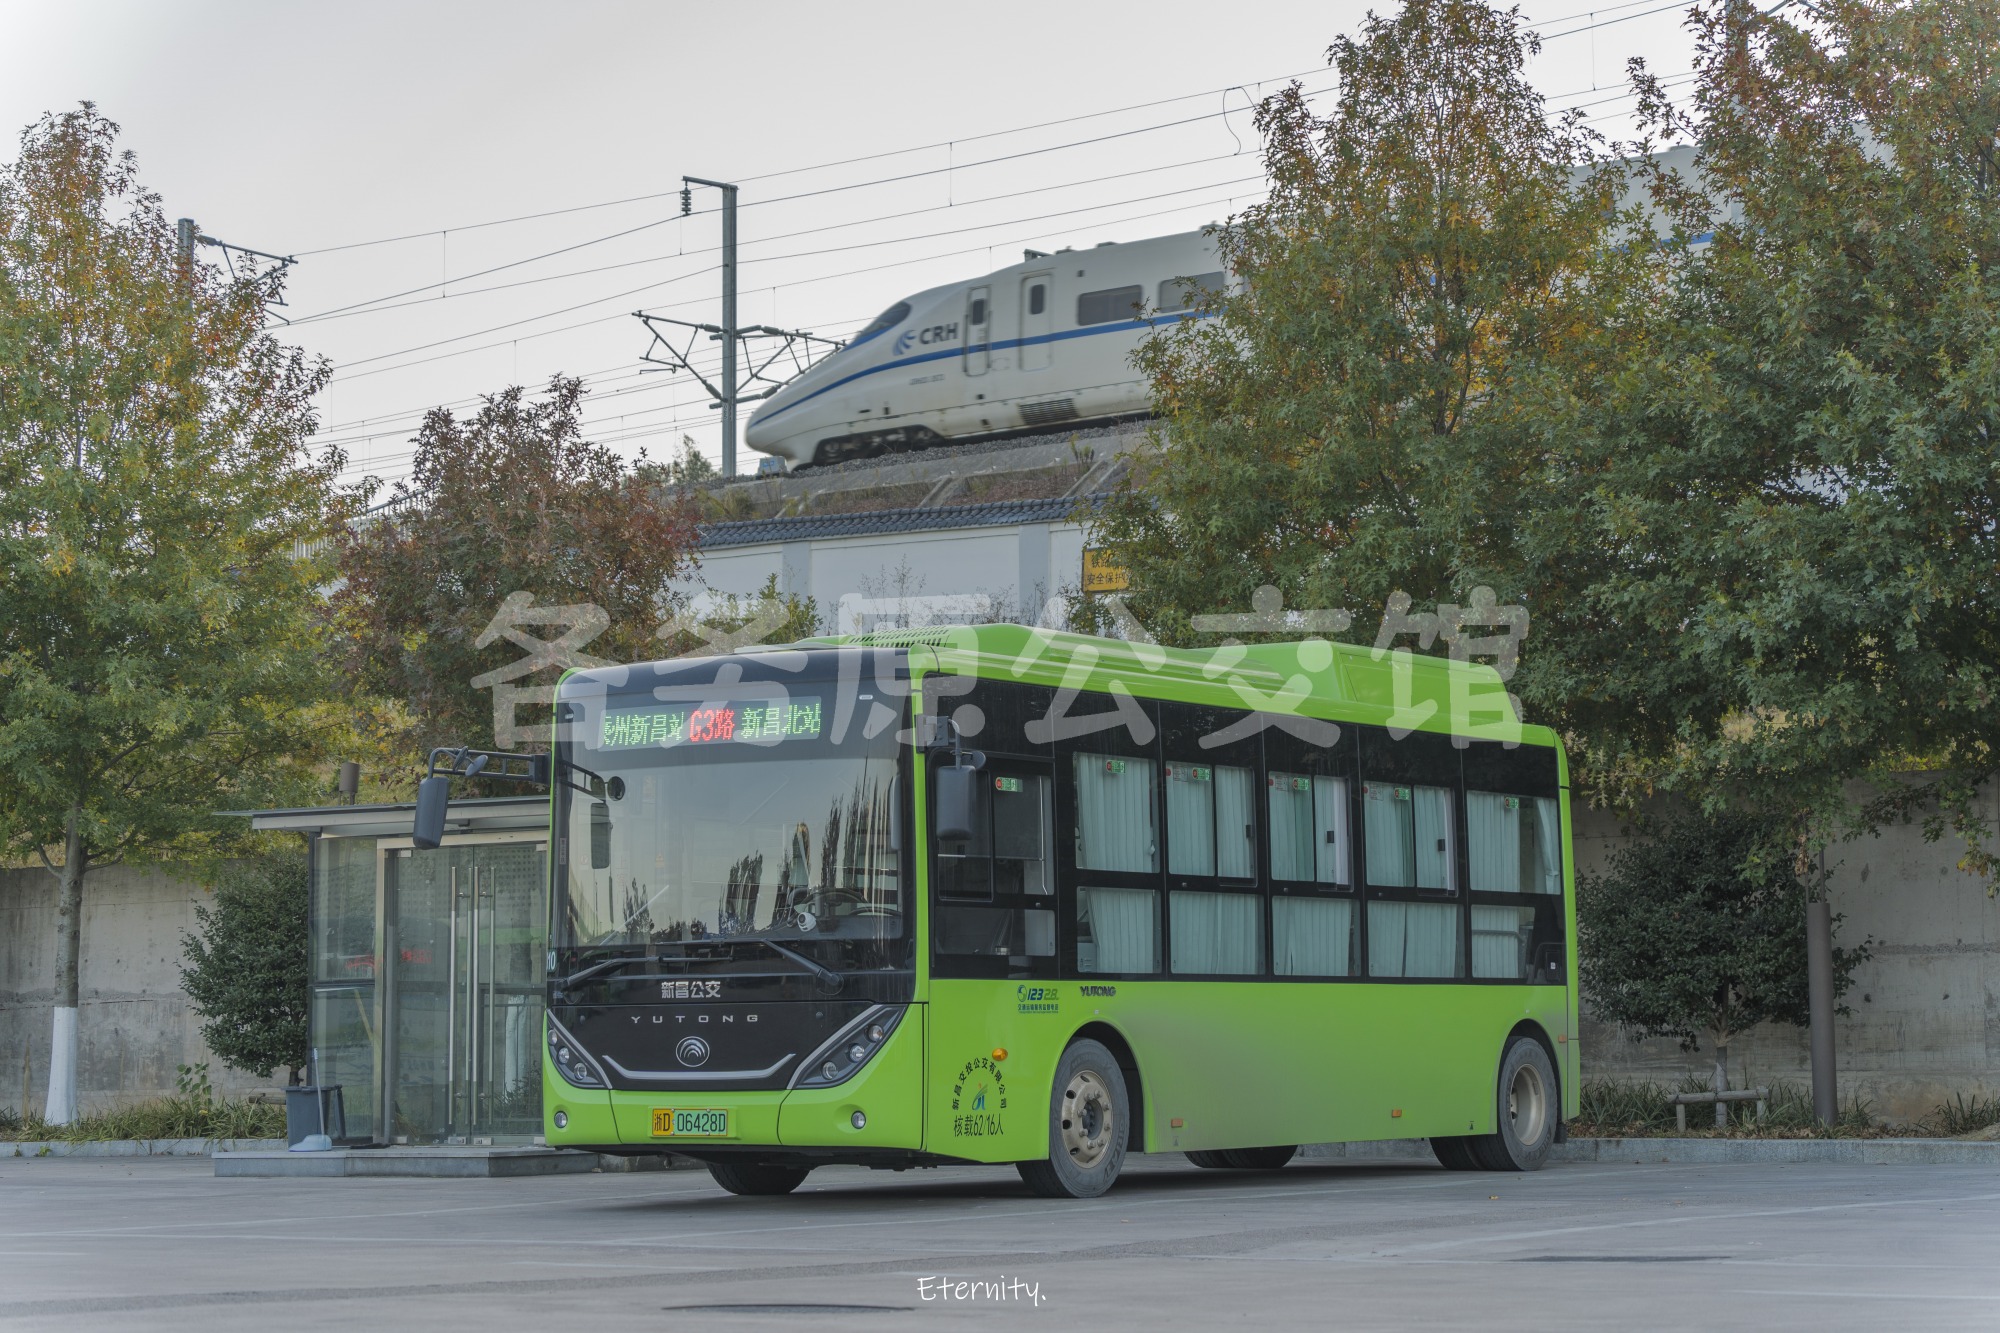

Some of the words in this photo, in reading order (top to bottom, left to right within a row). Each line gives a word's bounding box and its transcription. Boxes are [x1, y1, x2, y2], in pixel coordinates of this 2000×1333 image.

[919, 322, 959, 345] CRH
[1087, 572, 1128, 586] 安全保护
[689, 708, 735, 742] G3路
[740, 703, 821, 739] 新昌北站
[661, 981, 721, 998] 新昌公交
[1027, 988, 1059, 1000] 12328
[1080, 985, 1117, 996] YUTONG
[631, 1014, 759, 1024] YUTONG
[952, 1057, 1007, 1110] 新昌交投公交有限公司
[953, 1113, 1004, 1137] 核载62/16人
